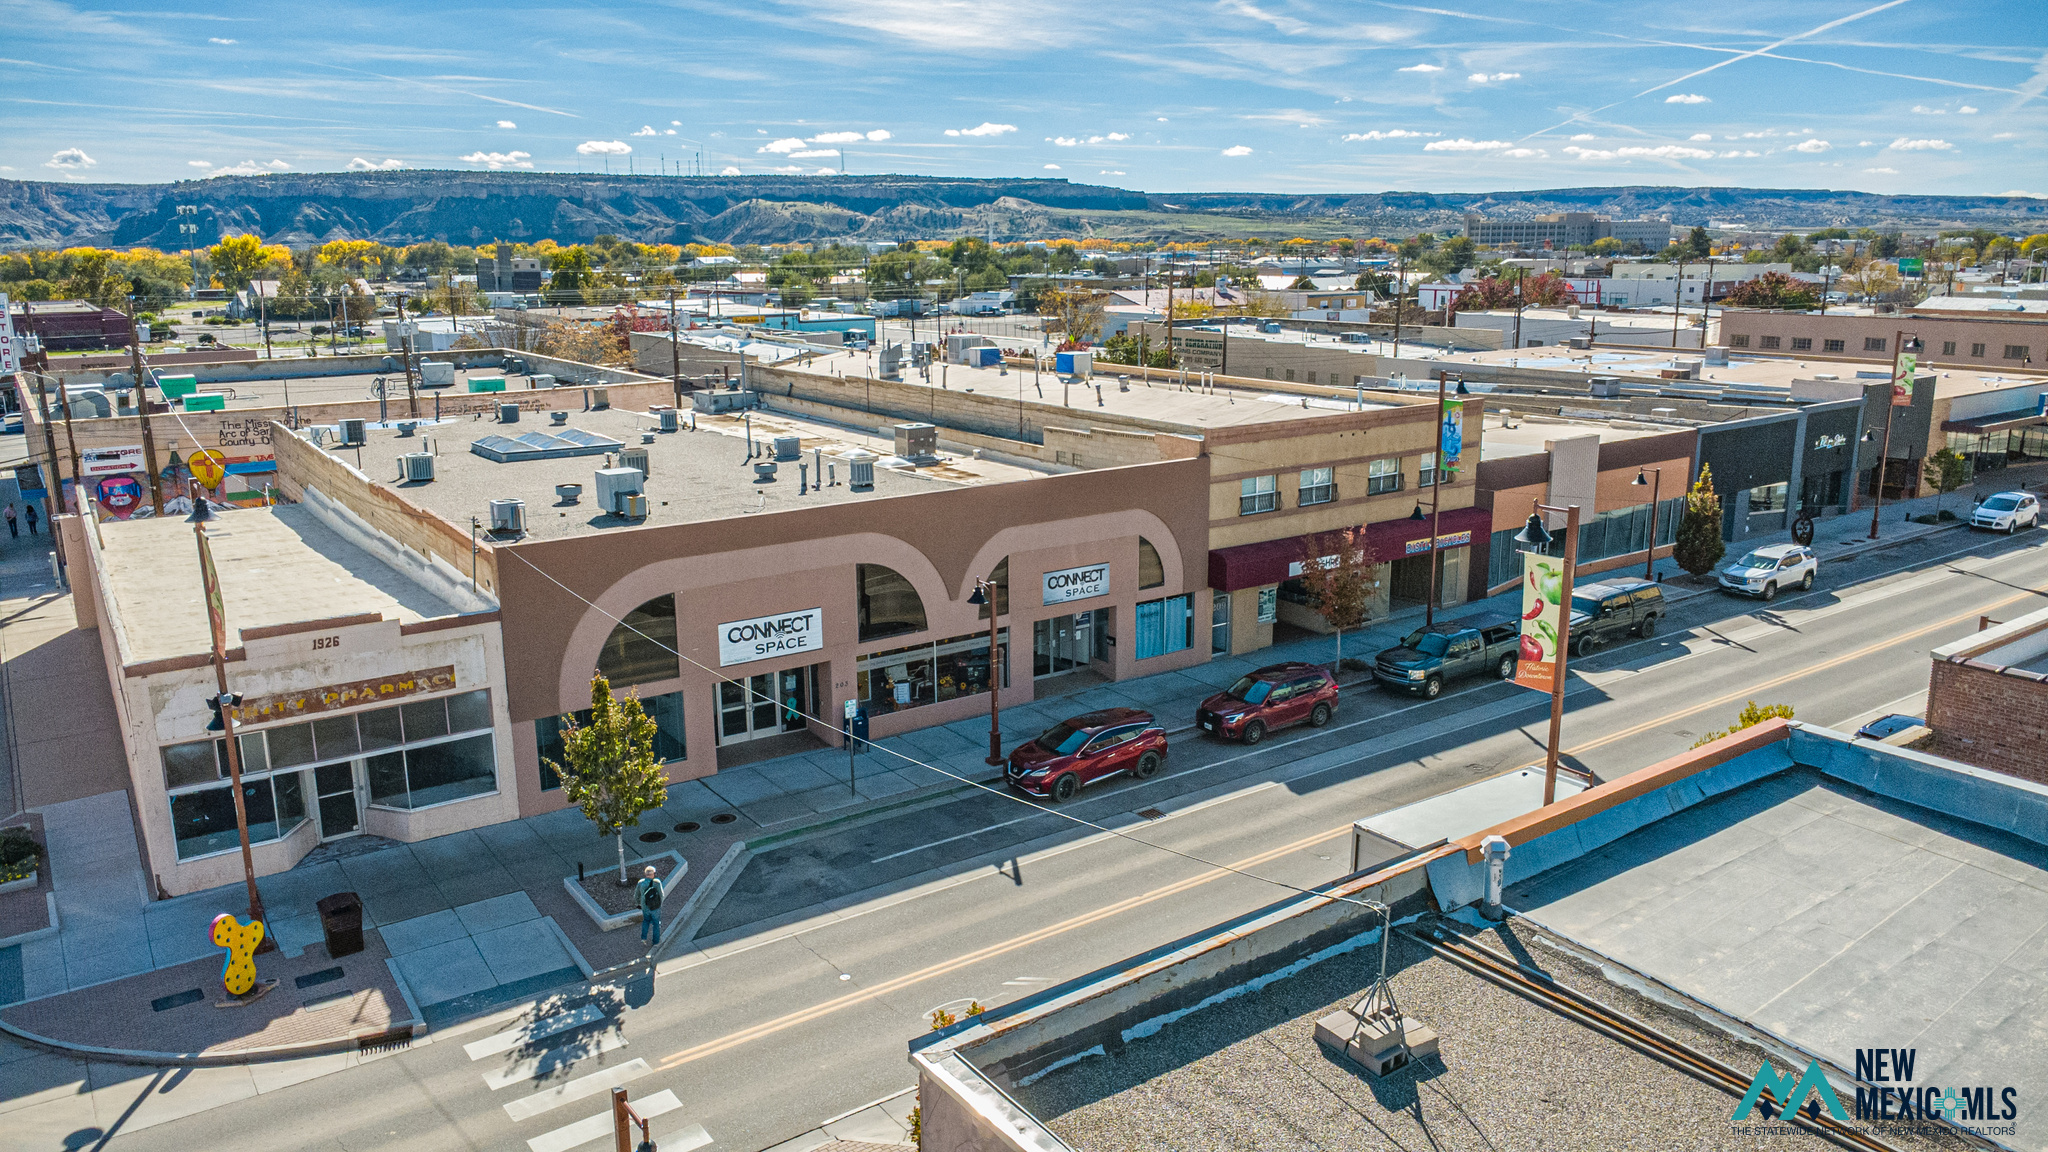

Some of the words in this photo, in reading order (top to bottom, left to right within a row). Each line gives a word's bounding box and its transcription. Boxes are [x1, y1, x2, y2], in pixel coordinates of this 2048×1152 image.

[0, 311, 12, 369] STORE
[1164, 336, 1182, 346] FTH
[1185, 338, 1223, 350] GENERATION
[1192, 349, 1222, 357] COMPANY
[221, 421, 241, 429] The
[219, 430, 237, 438] Arc
[240, 428, 251, 438] of
[220, 438, 255, 446] County
[91, 463, 132, 472] DONATIONS
[1406, 541, 1428, 554] BISTI
[1047, 568, 1106, 590] CONNECT
[1065, 584, 1100, 598] SPACE
[728, 615, 813, 643] CONNECT
[312, 636, 340, 650] 1926
[755, 636, 807, 654] SPACE
[1526, 663, 1549, 671] Historic
[1519, 670, 1552, 679] Downtown
